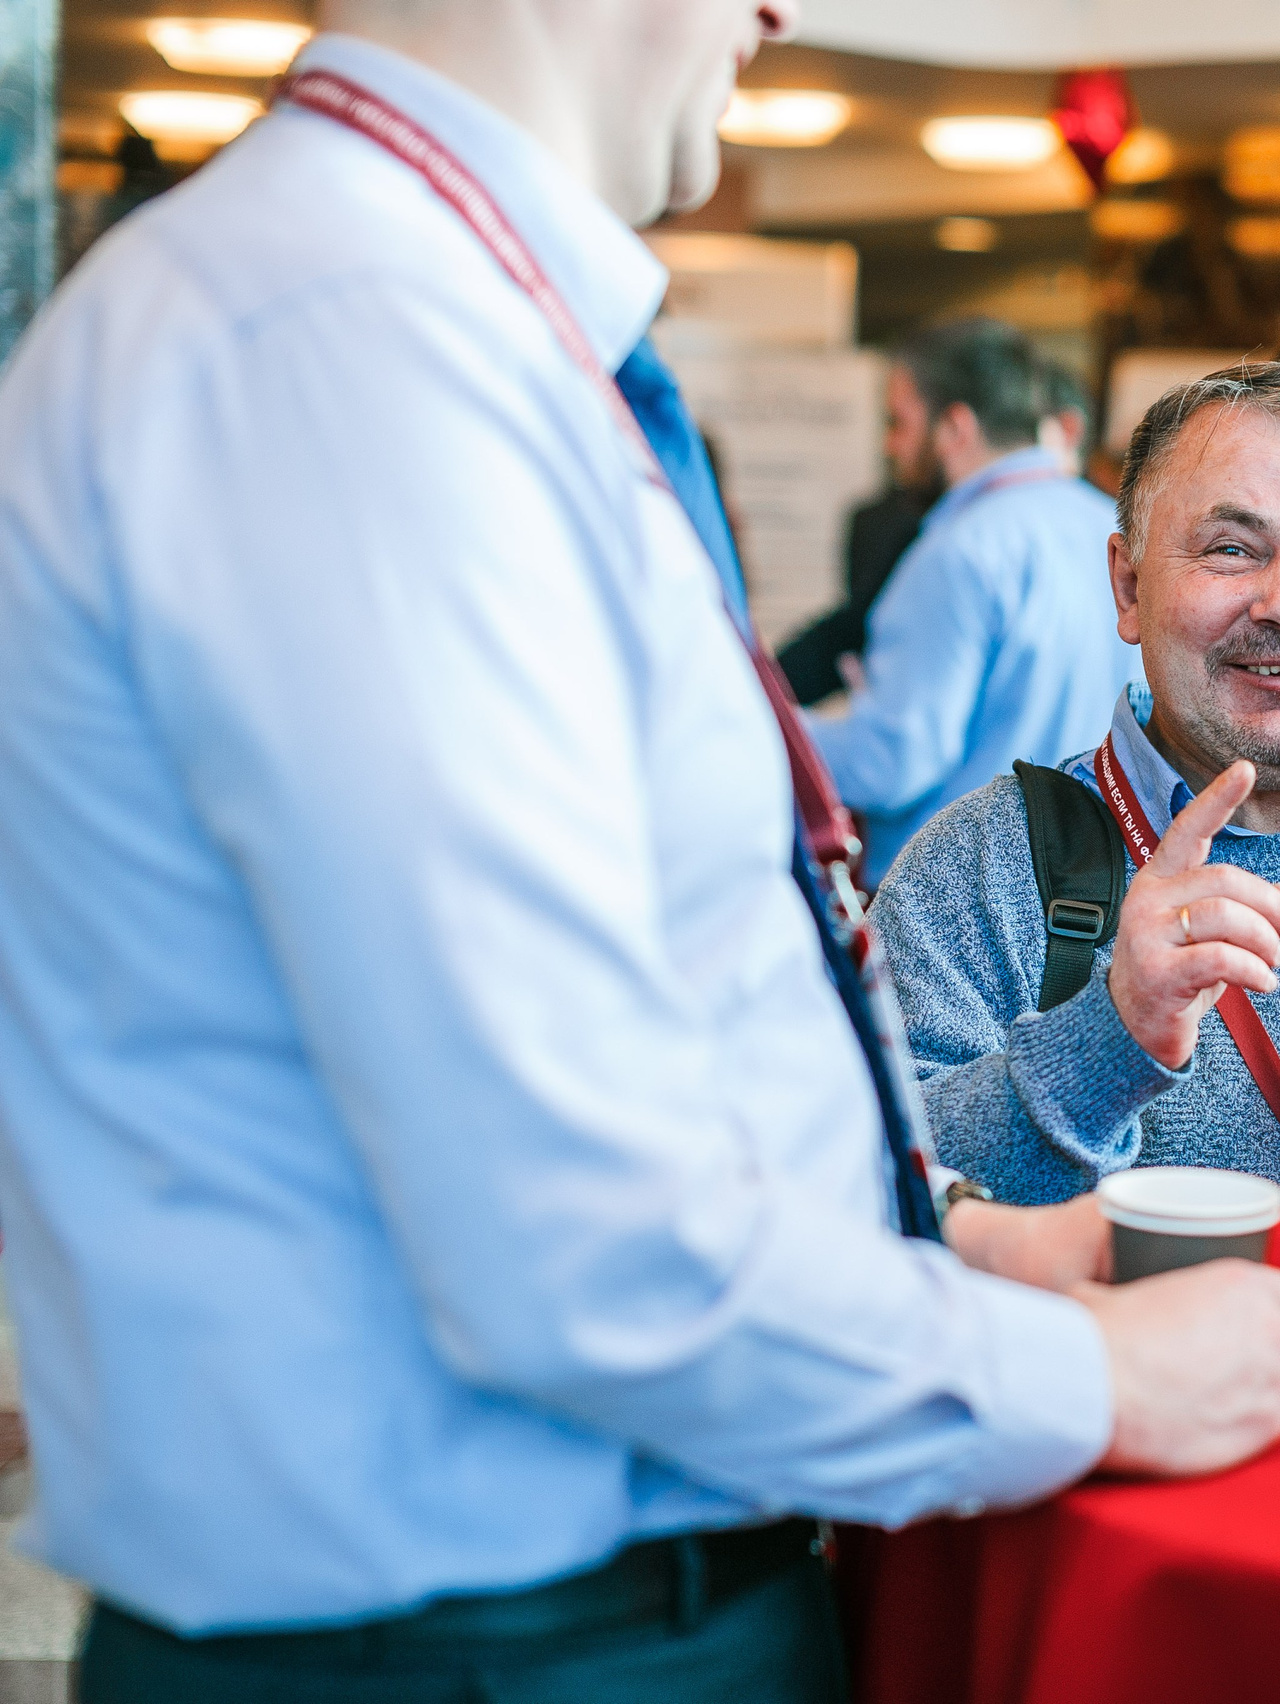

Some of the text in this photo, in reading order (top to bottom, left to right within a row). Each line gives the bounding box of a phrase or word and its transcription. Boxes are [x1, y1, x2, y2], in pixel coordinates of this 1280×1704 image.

[1111, 787, 1128, 816] ЕСЛИ
[1123, 813, 1136, 831] ТЫ
[1130, 829, 1144, 847] НА
[1140, 846, 1154, 864] ФО
